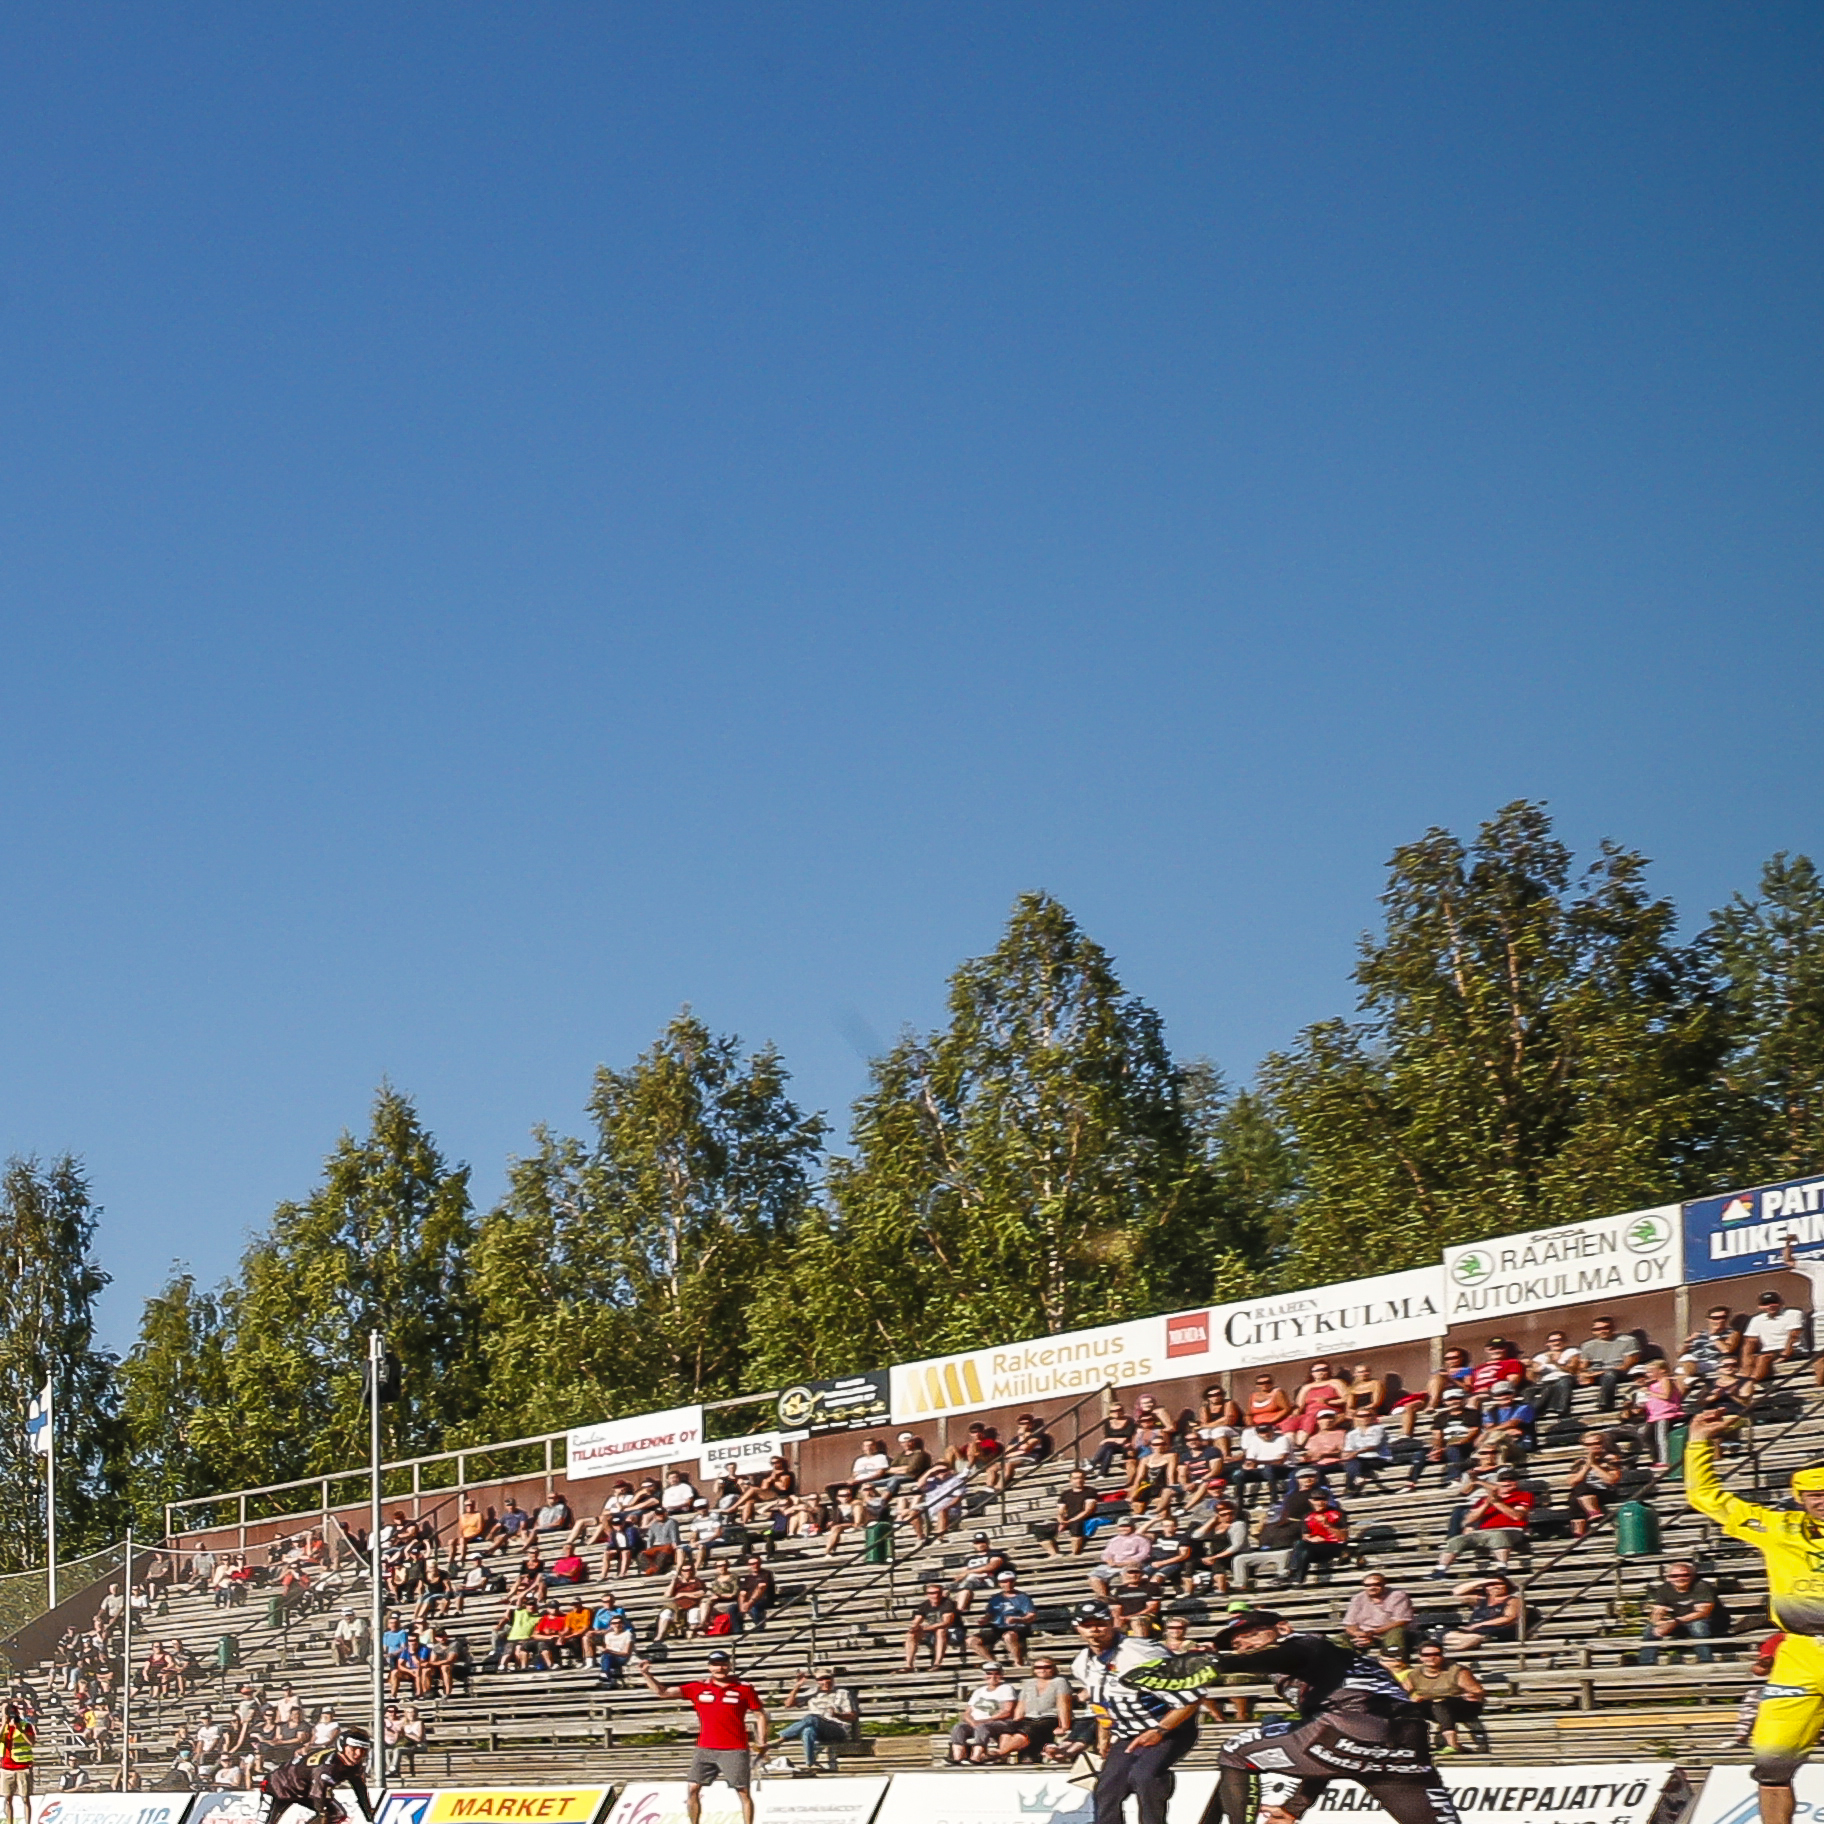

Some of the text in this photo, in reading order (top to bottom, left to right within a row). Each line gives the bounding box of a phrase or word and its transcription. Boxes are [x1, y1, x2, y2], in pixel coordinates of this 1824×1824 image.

[1500, 1230, 1618, 1272] RAAHEN
[1453, 1256, 1670, 1314] AUTOKULMA OY
[1224, 1295, 1440, 1347] CITYKULMA
[1254, 1299, 1318, 1319] RAAHEN
[992, 1336, 1125, 1375] Rakennus
[991, 1357, 1153, 1400] Miilukangas
[679, 1429, 699, 1443] OY
[449, 1797, 577, 1817] MARKET
